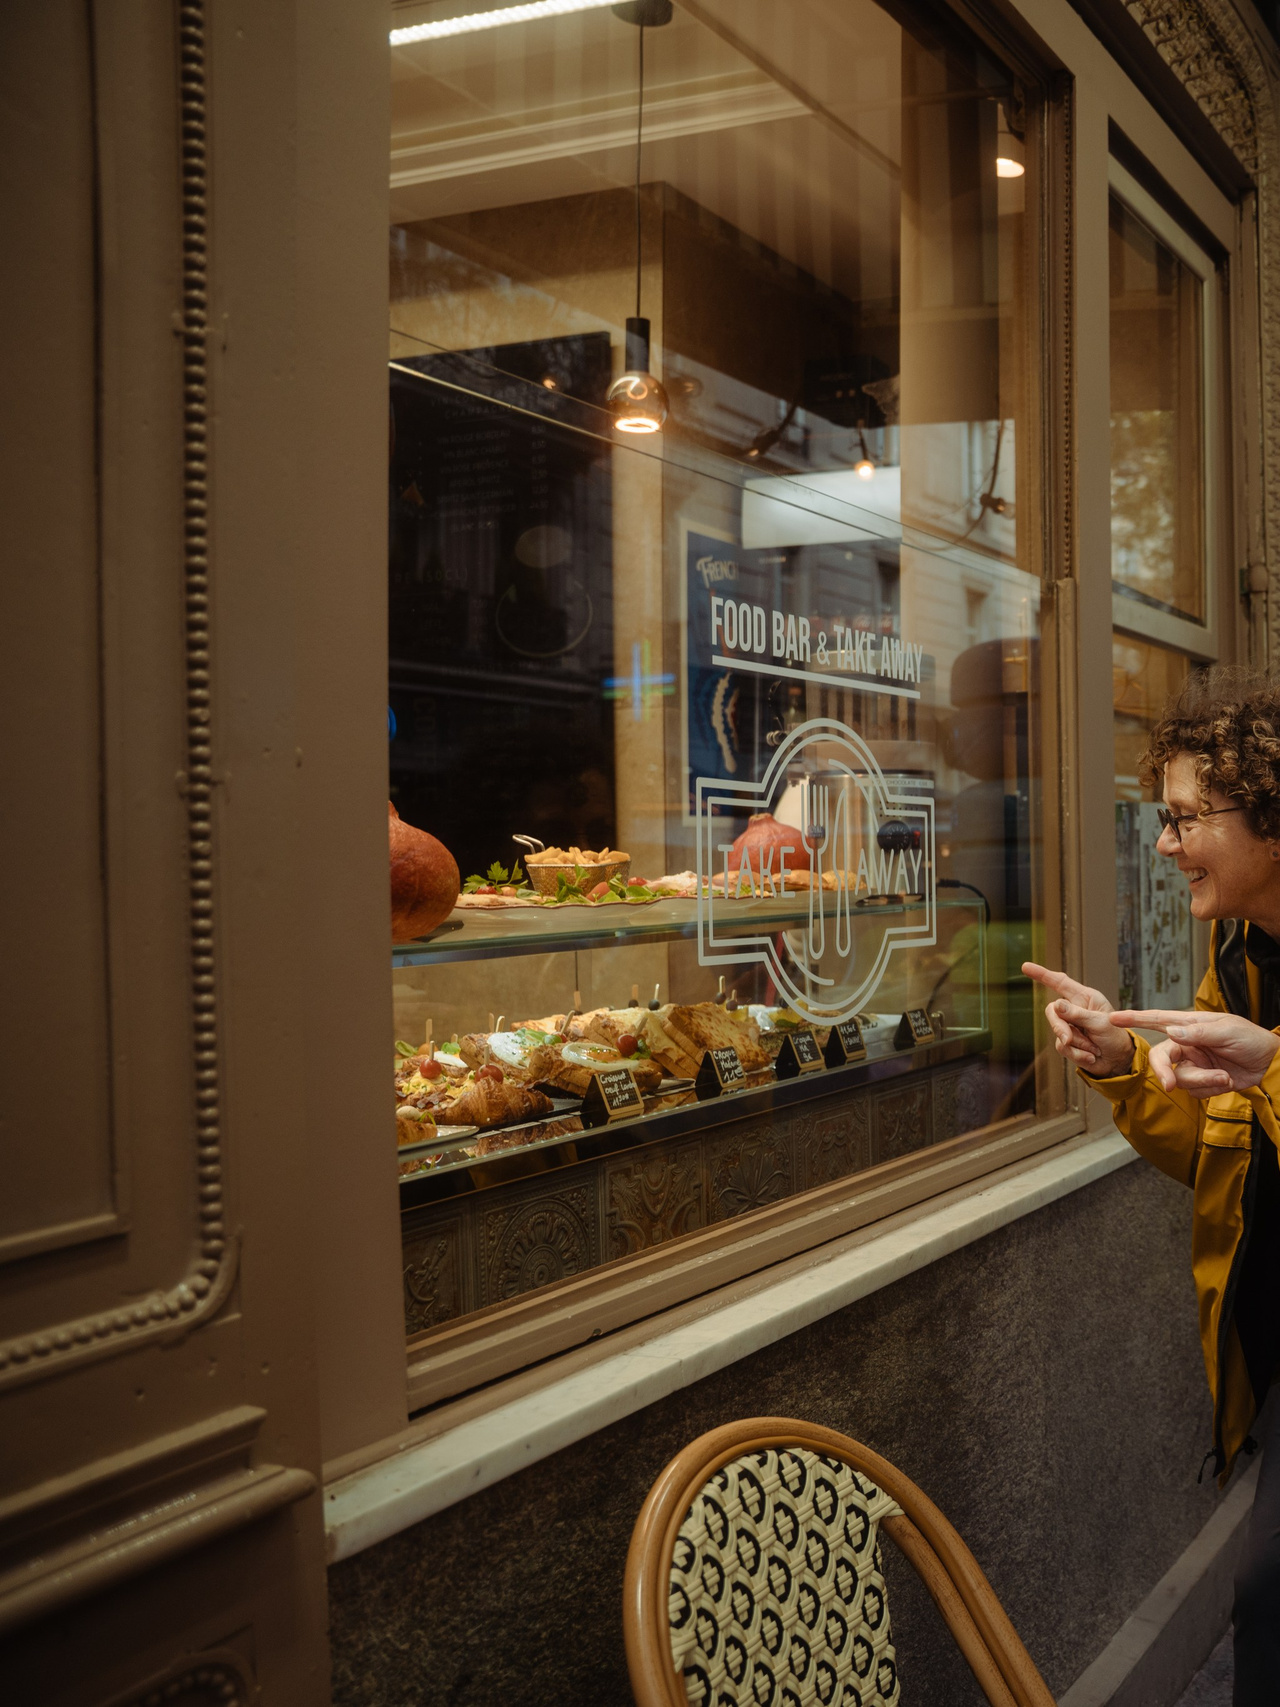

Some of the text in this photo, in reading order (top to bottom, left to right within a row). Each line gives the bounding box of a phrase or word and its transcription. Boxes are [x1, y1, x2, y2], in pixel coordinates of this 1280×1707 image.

[711, 596, 923, 684] FOOD BAR & TAKE AWAY
[718, 844, 923, 899] TAKE AWAY
